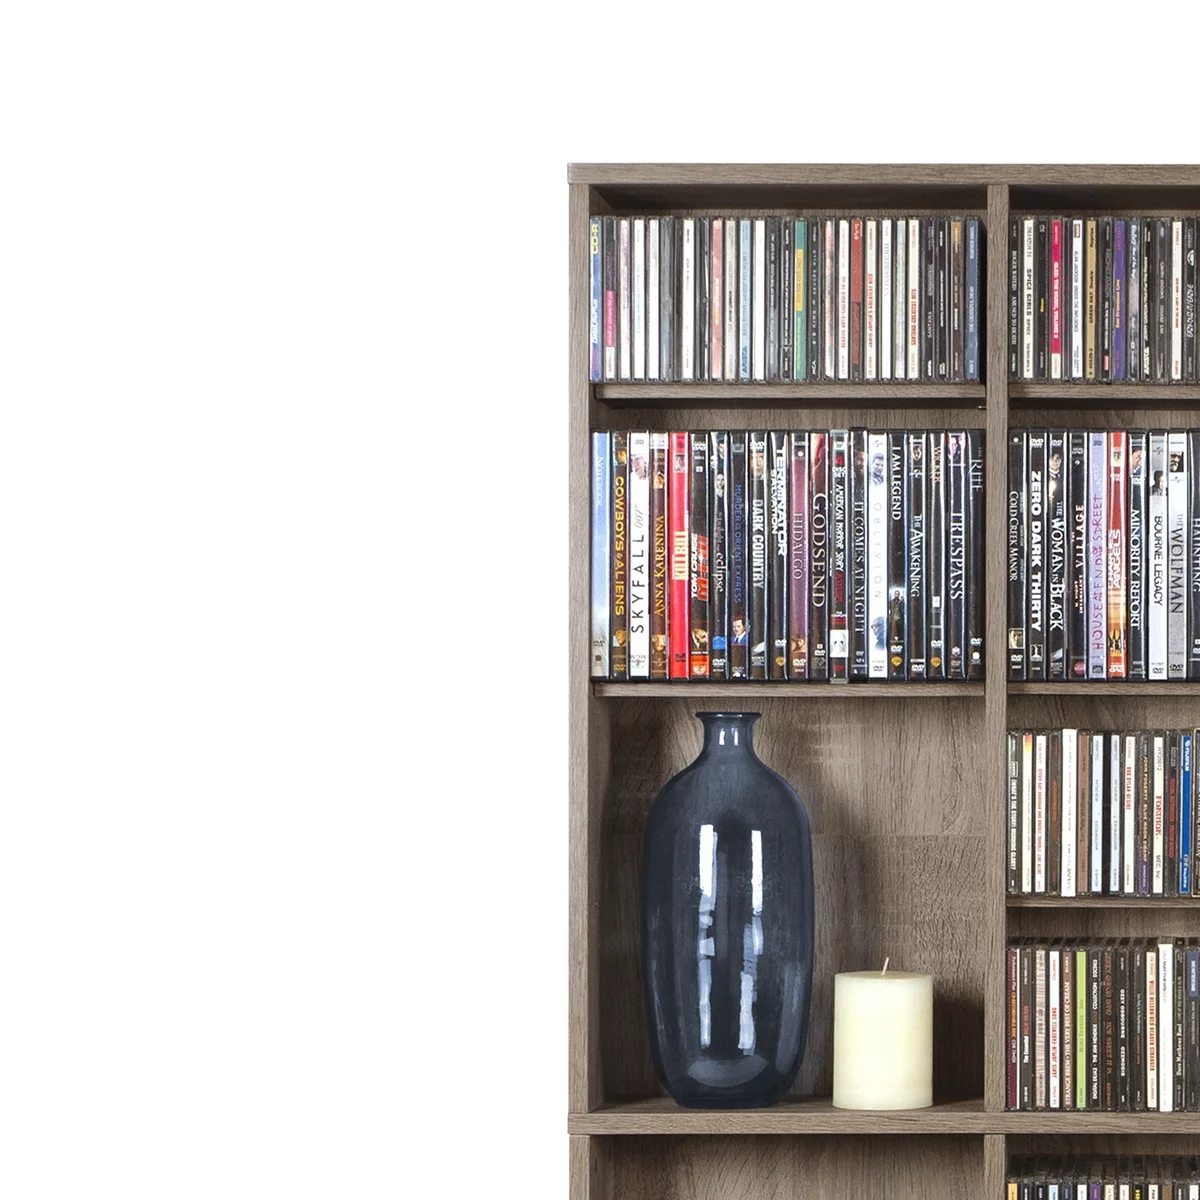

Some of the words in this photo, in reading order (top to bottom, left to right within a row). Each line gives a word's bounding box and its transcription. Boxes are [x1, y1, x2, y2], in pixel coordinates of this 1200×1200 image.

[892, 452, 900, 472] AM
[615, 476, 624, 552] COWBOYS
[734, 485, 742, 521] MURDER
[752, 500, 764, 531] DARK
[777, 447, 787, 556] TERMINATOR
[892, 475, 901, 520] LEGEND
[1009, 491, 1019, 516] COLD
[1032, 471, 1041, 516] ZERO
[654, 515, 664, 578] KARENINA
[734, 532, 742, 562] ORIENT
[792, 513, 804, 579] HIDALGO
[812, 493, 826, 607] GODSEND
[874, 503, 882, 598] OBLIVION
[950, 510, 963, 600] TRESPASS
[1009, 518, 1019, 547] CREEK
[1032, 521, 1041, 567] DARK
[1051, 518, 1063, 572] WOMAN
[1131, 509, 1140, 577] MINORITY
[1154, 516, 1163, 560] BOURNE
[1192, 518, 1200, 592] HAUNTING
[631, 535, 644, 633] SKYFALL
[712, 553, 726, 592] eclipse
[734, 565, 742, 603] EXPRESS
[753, 535, 764, 589] COUNTRY
[1009, 549, 1019, 581] MANOR
[1154, 564, 1163, 606] LEGACY
[615, 561, 624, 615] ALIENS
[654, 582, 664, 616] ANNA
[1032, 572, 1041, 631] THIRTY
[1050, 583, 1064, 631] BLACK
[1131, 581, 1140, 629] REPORT
